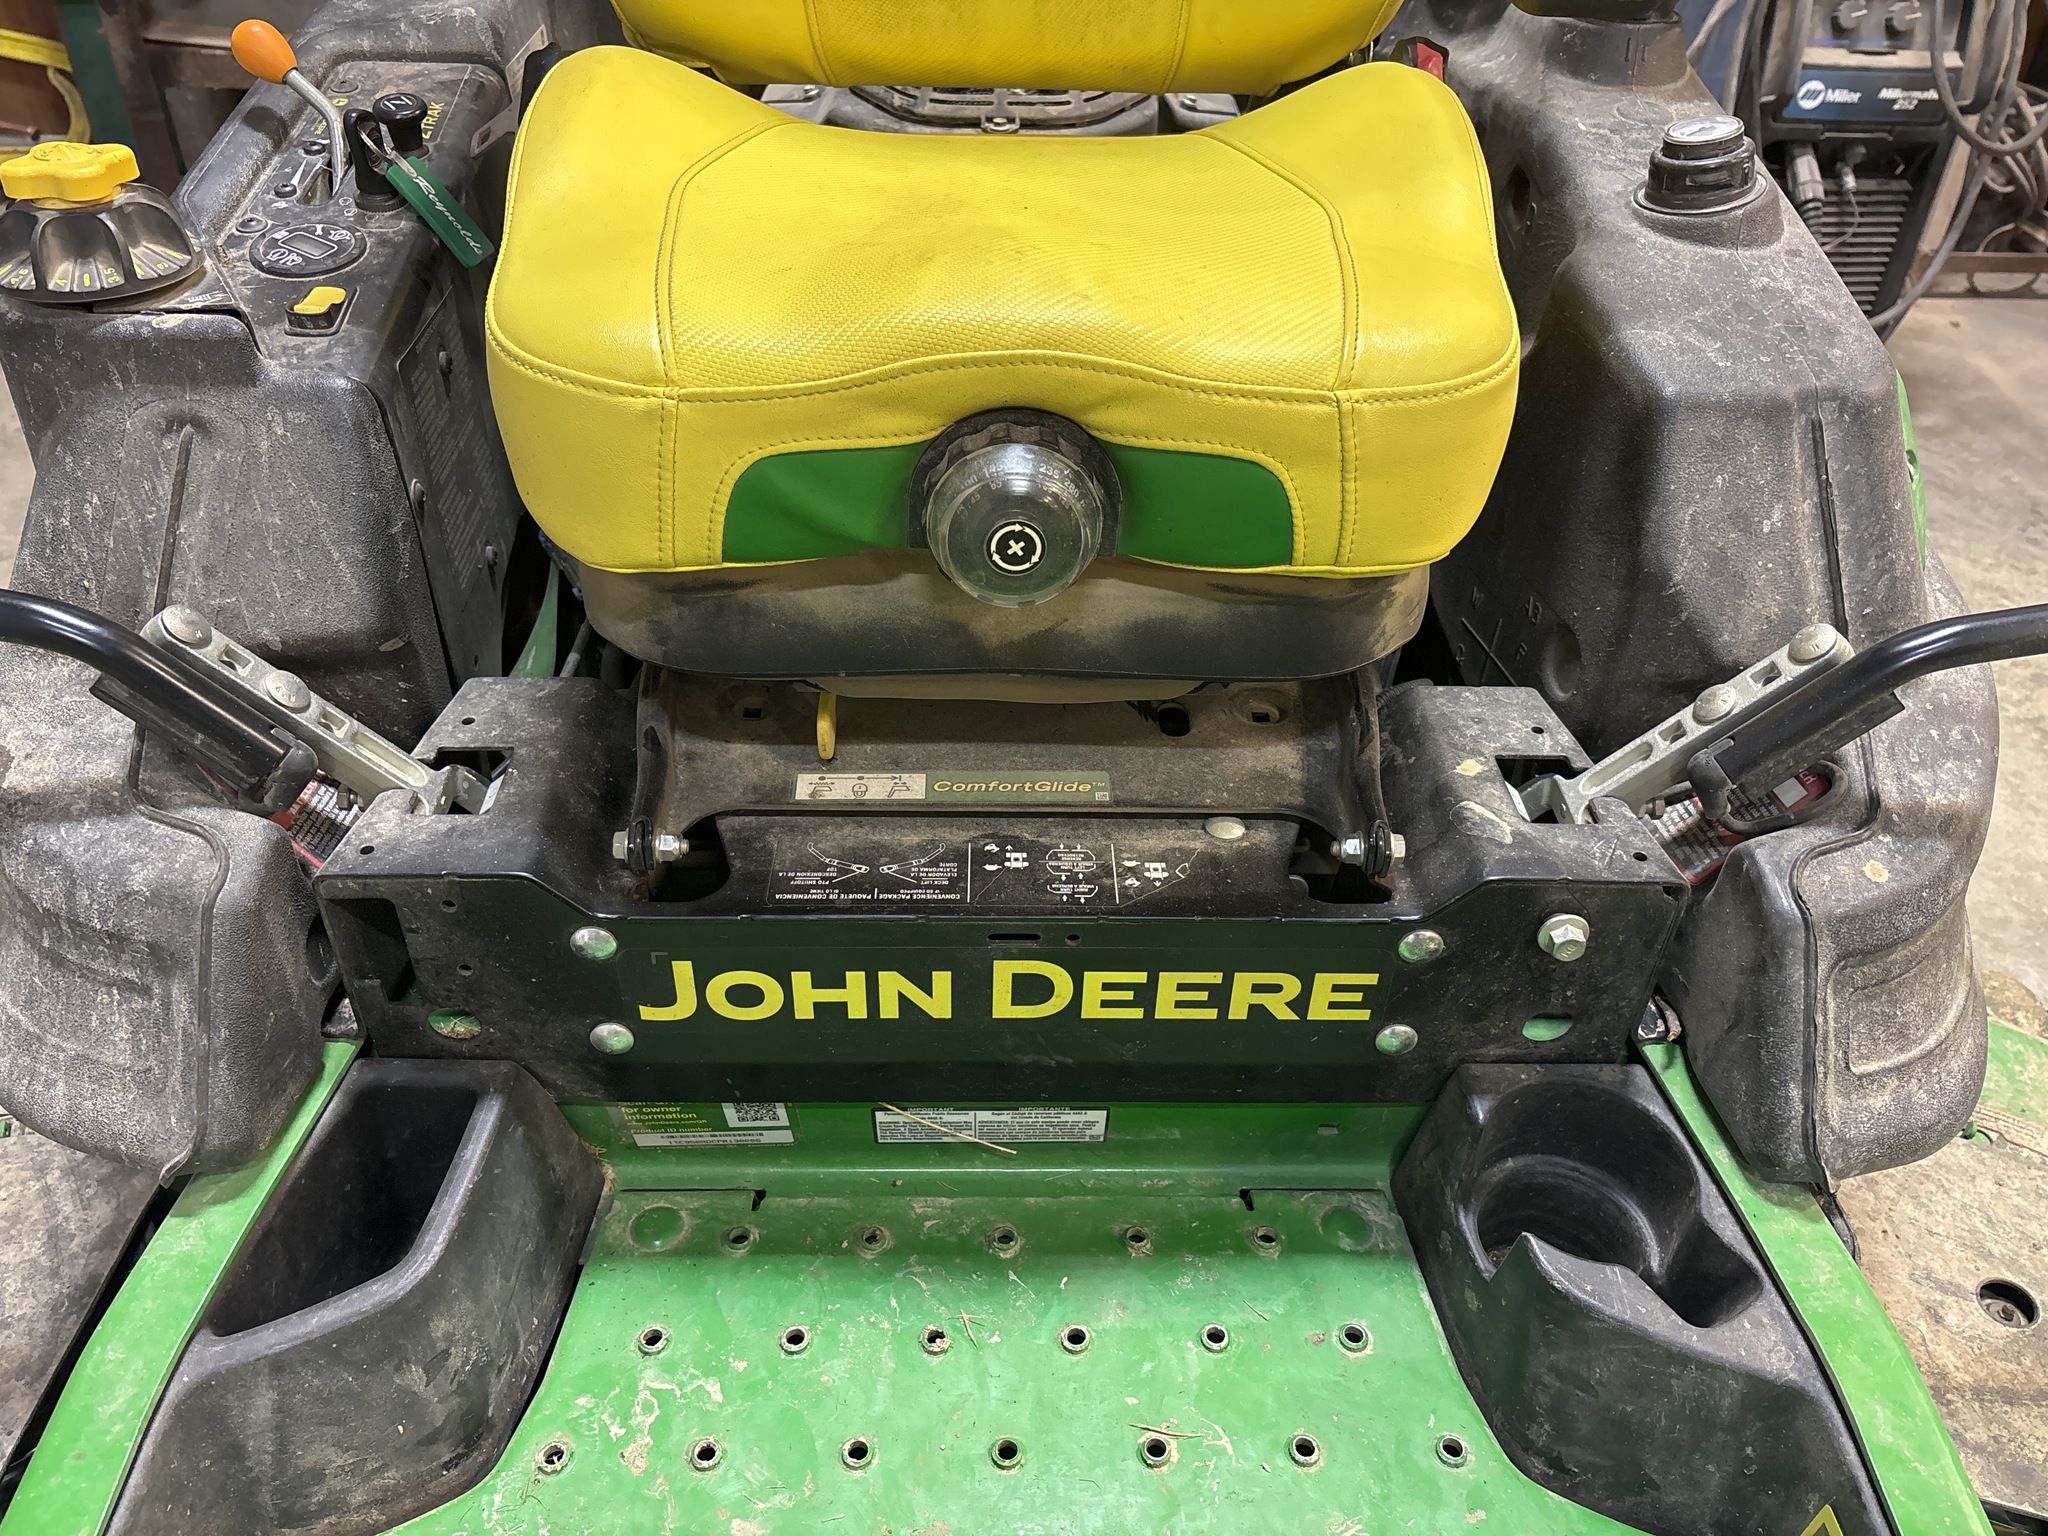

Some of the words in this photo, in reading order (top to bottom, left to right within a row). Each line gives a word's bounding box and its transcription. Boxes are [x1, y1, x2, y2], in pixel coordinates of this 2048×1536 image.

[104, 267, 120, 284] 3.5
[1039, 463, 1061, 479] 235
[638, 960, 953, 1022] JOHN
[991, 959, 1380, 1022] DEERE
[621, 1106, 639, 1114] for
[624, 1112, 698, 1121] information
